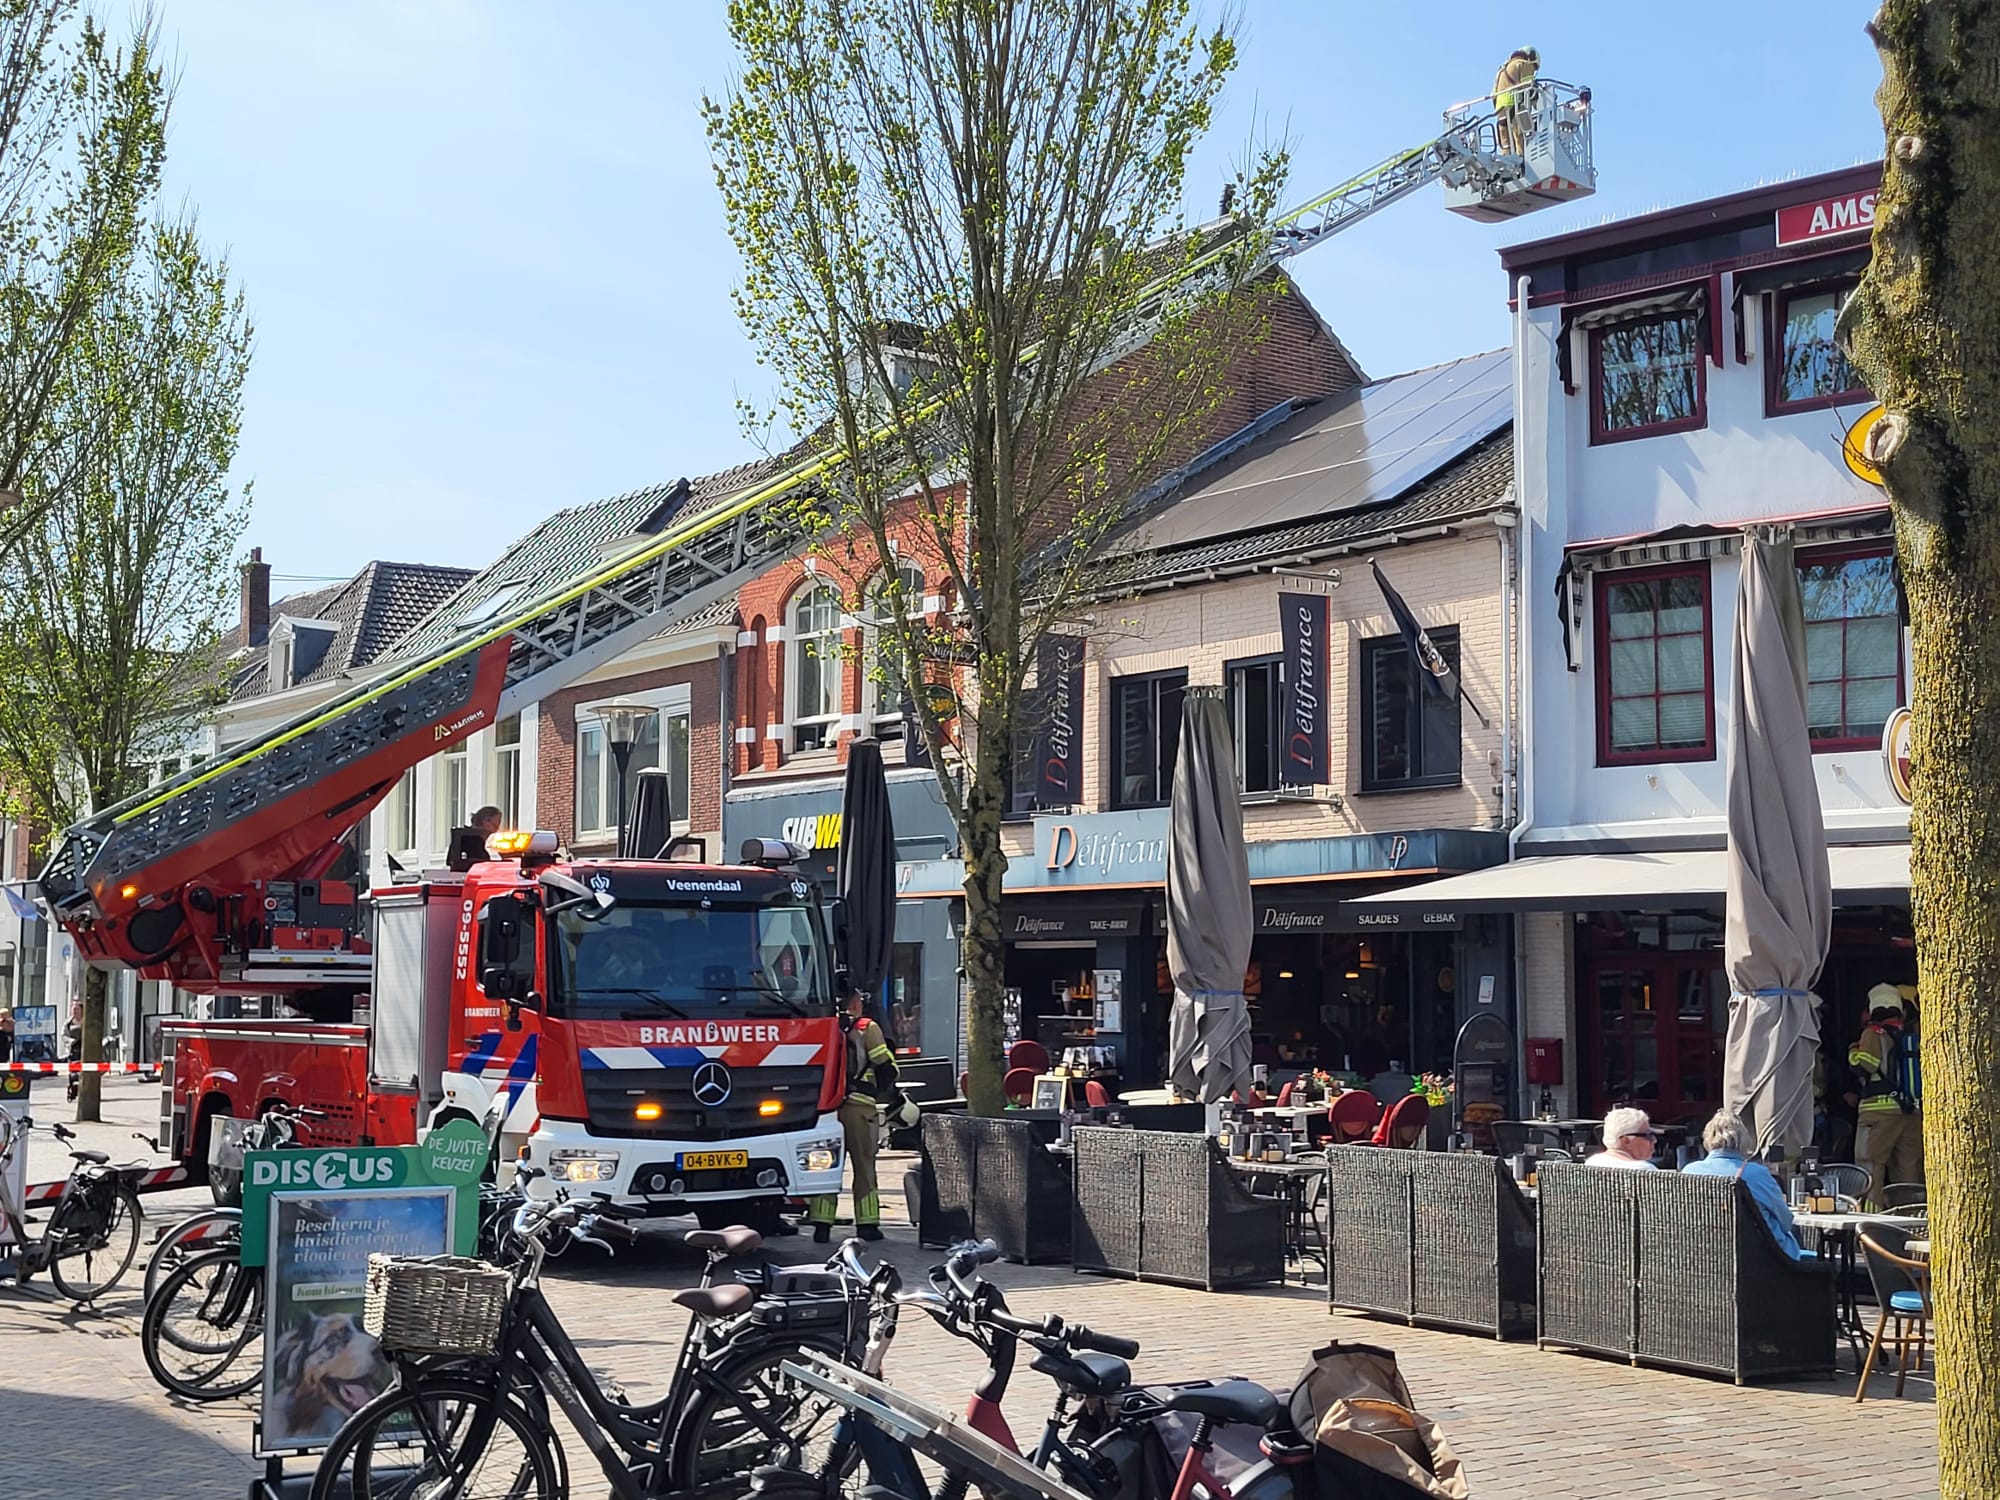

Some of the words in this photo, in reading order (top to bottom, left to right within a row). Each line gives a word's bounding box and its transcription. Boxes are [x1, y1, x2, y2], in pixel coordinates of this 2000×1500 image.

[1808, 194, 1877, 234] AMS
[1290, 606, 1317, 771] Délifrance
[1046, 646, 1073, 793] Délifrance
[782, 813, 843, 850] SUBWA
[1045, 825, 1163, 875] Délifran
[666, 879, 742, 891] Veenendaal
[1014, 915, 1064, 935] Délifrance
[1090, 920, 1128, 930] TAKE-AWAY
[1262, 908, 1324, 930] Délifrance
[1358, 914, 1399, 925] SALADES
[1423, 913, 1456, 923] GEBAK
[456, 899, 473, 980] 09-5552
[464, 1007, 500, 1017] BRANDWEER
[640, 1025, 780, 1044] BRANDWEER
[1535, 1048, 1545, 1057] 111
[429, 1137, 447, 1151] DE
[447, 1138, 485, 1156] JUISTE
[432, 1156, 476, 1173] KEUZE!
[687, 1153, 744, 1167] 04-BVK-9
[253, 1152, 393, 1189] DISCUS
[294, 1216, 372, 1233] Bescherm
[373, 1216, 390, 1232] je
[294, 1232, 362, 1248] huisdier
[294, 1247, 351, 1264] vlooien
